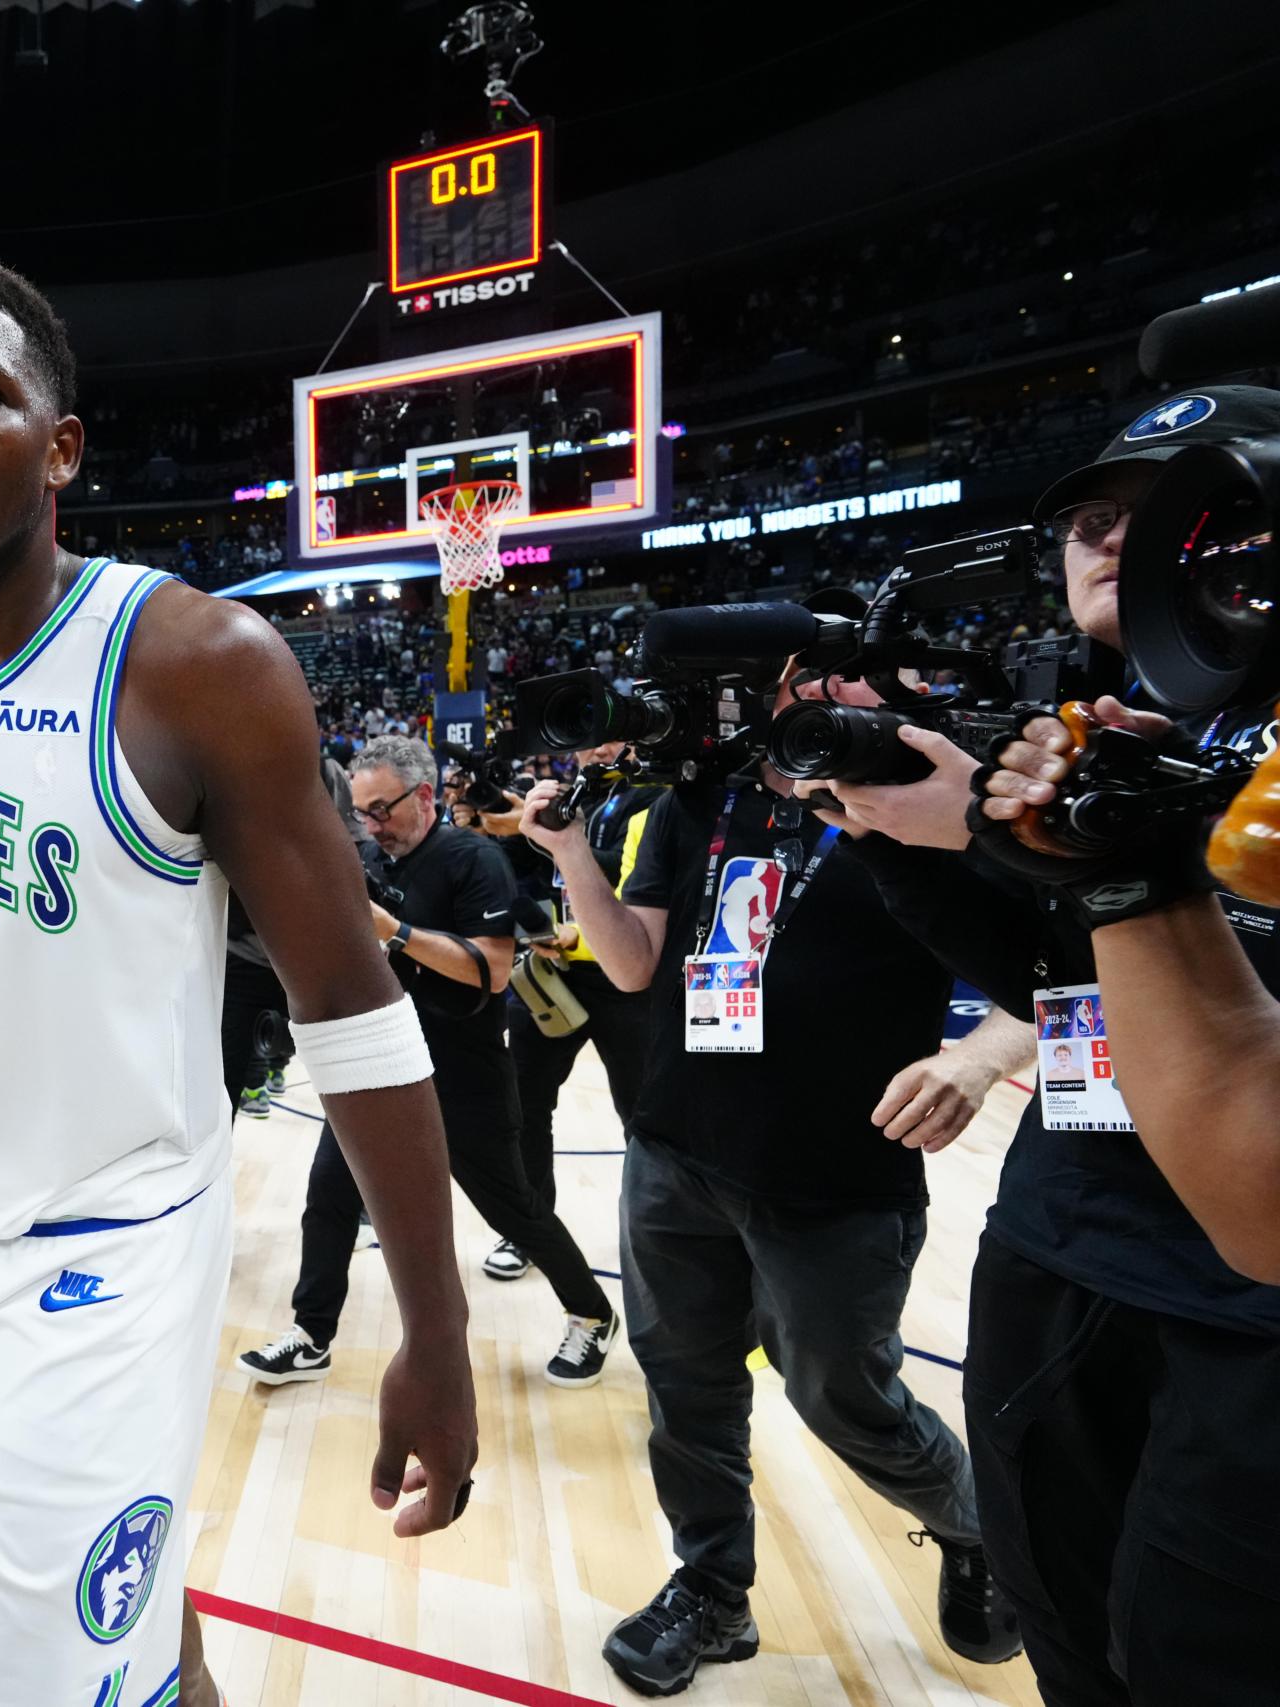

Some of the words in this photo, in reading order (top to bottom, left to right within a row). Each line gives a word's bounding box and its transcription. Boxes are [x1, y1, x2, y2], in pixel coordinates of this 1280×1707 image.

[431, 153, 496, 204] 0.0
[433, 272, 535, 308] TISSOT
[976, 539, 1012, 553] SONY
[447, 723, 473, 744] GET
[53, 1269, 105, 1299] NIKE
